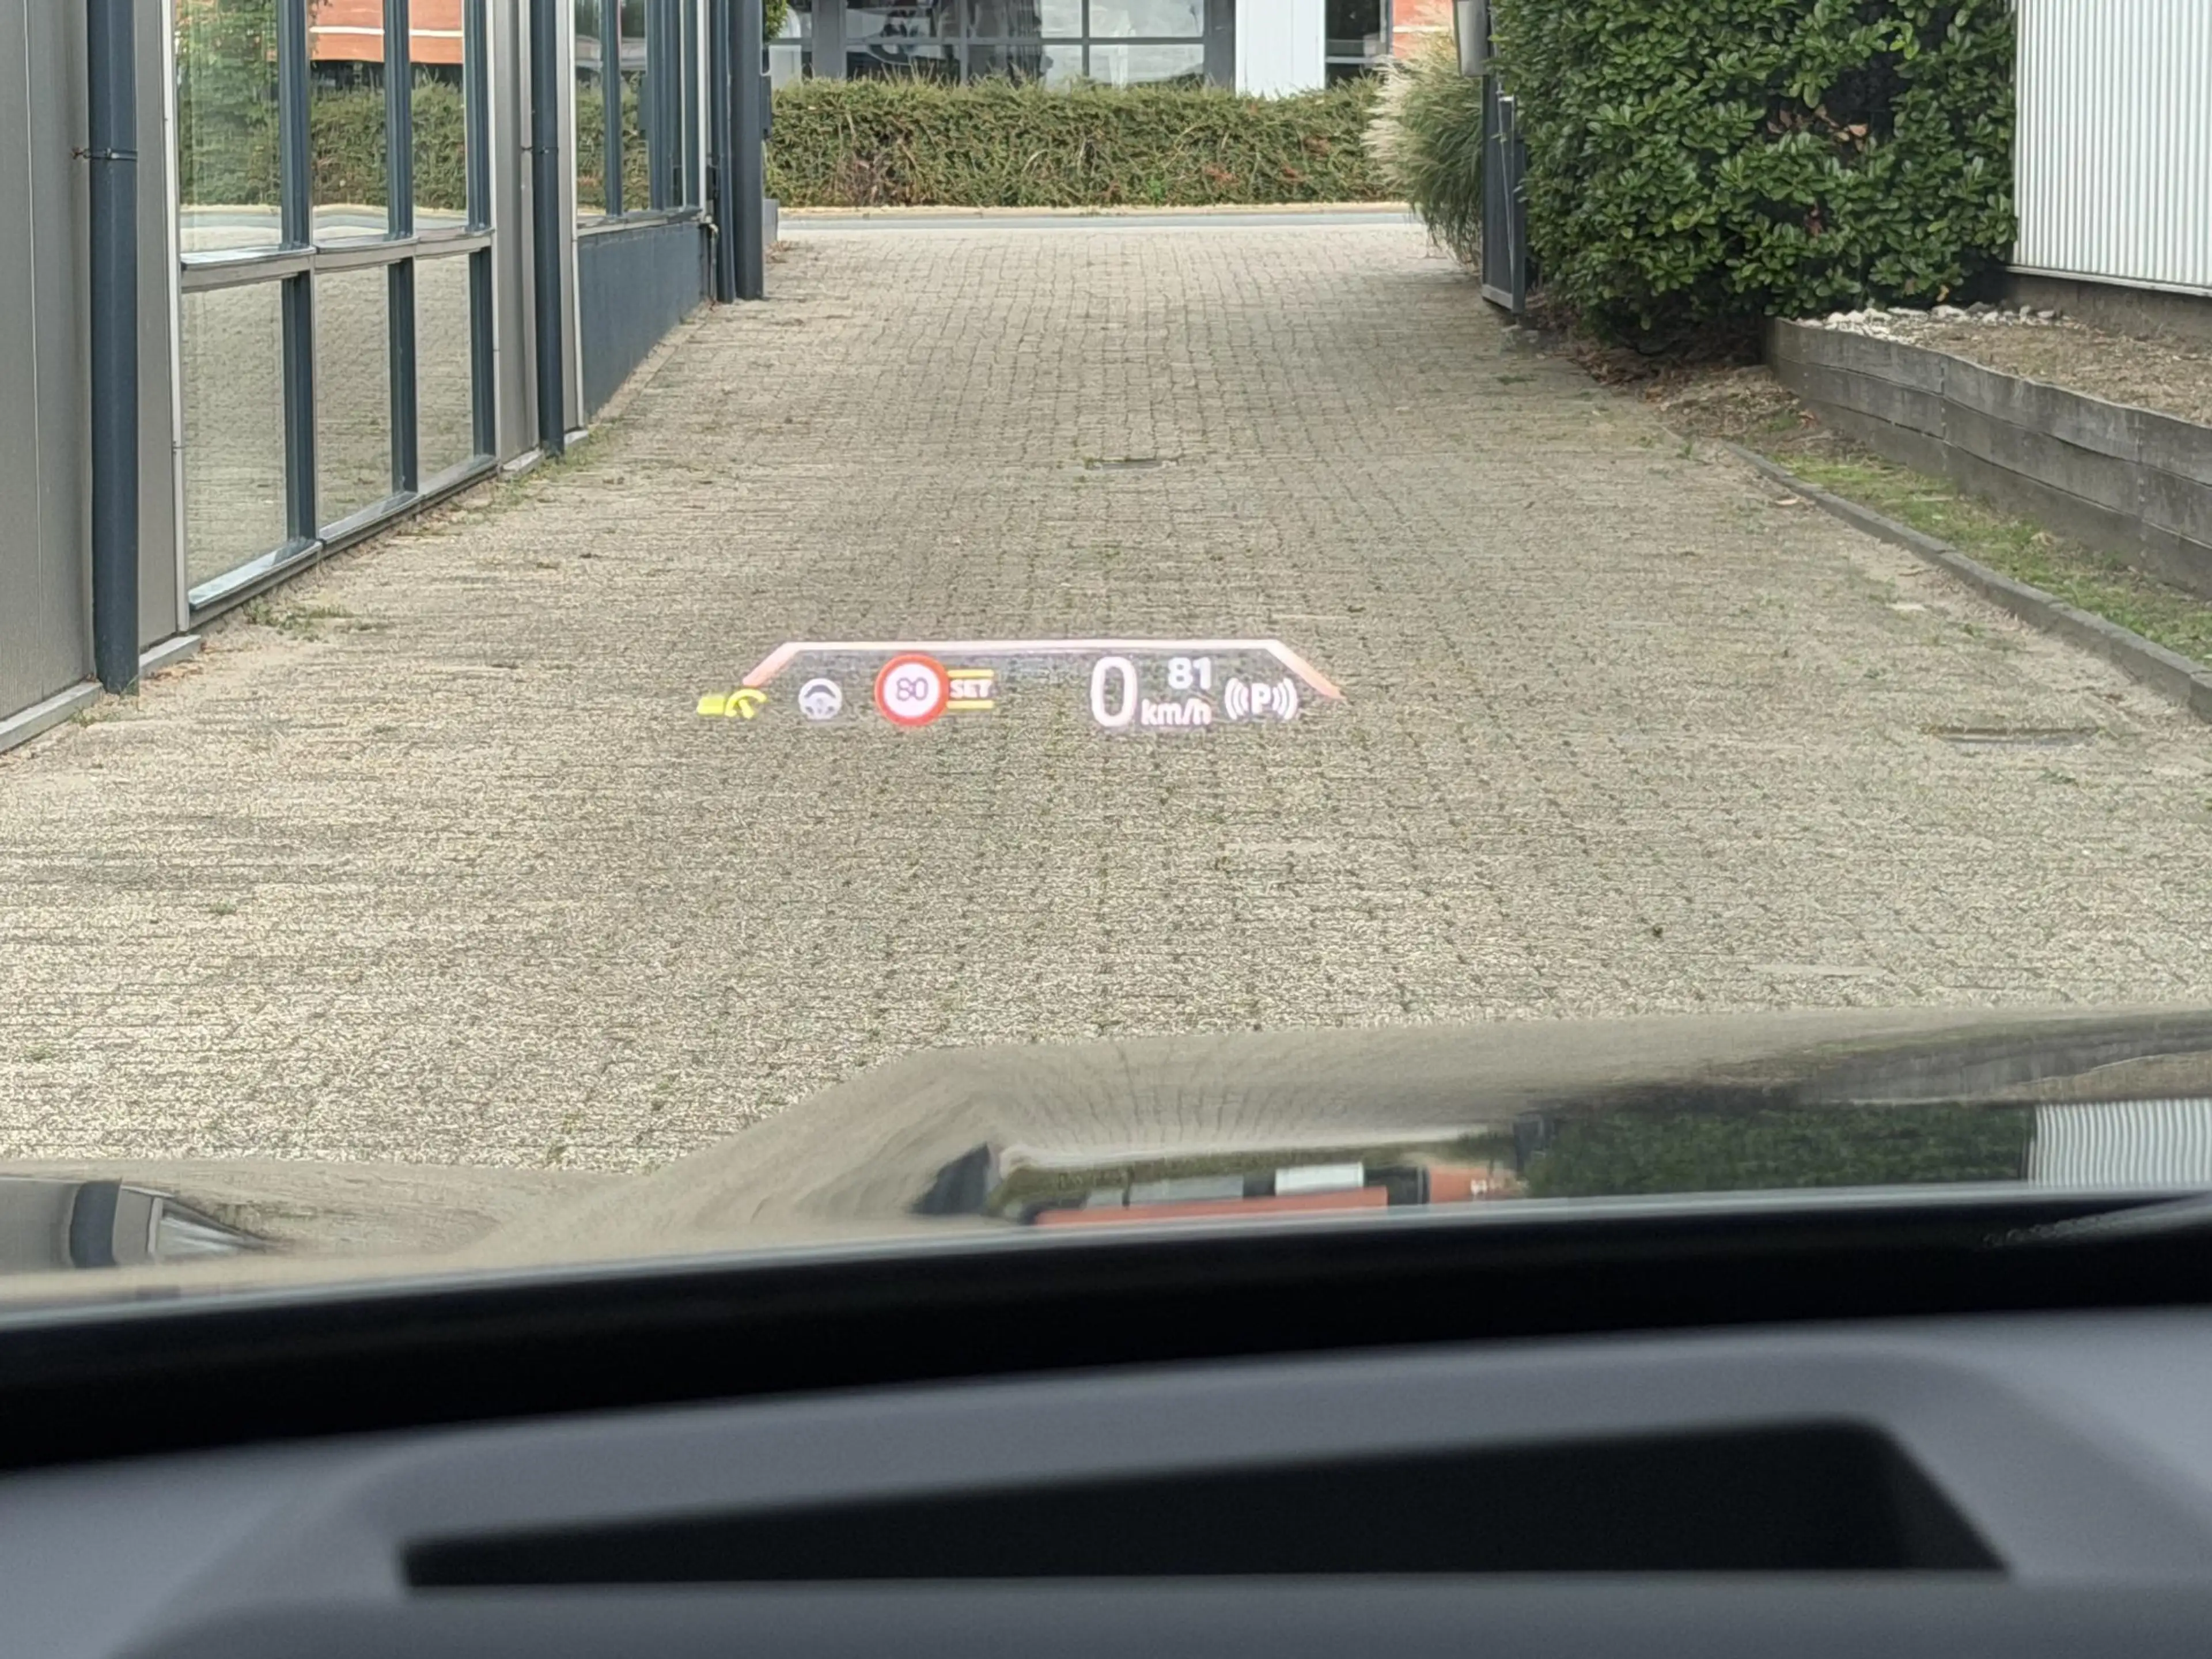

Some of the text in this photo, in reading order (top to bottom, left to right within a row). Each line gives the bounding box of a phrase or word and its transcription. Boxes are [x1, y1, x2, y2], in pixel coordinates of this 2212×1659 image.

[1091, 657, 1211, 727] 0 km/h
[1168, 657, 1211, 690] 81
